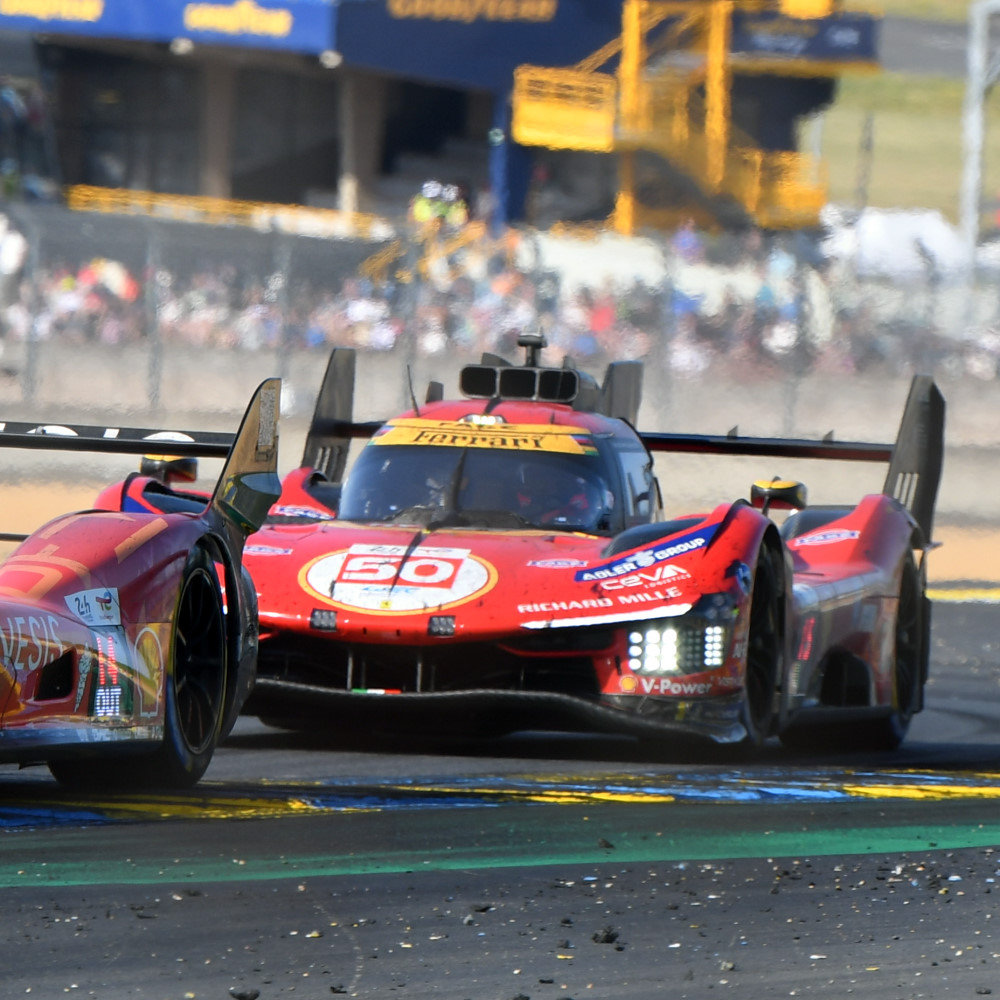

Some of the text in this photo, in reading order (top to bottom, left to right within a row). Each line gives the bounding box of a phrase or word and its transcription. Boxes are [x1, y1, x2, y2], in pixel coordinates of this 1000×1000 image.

[341, 556, 455, 584] 50
[582, 561, 637, 581] ADLER
[654, 537, 706, 561] GROUP
[517, 586, 683, 613] RICHARD MILLE
[641, 678, 713, 694] V-Power
